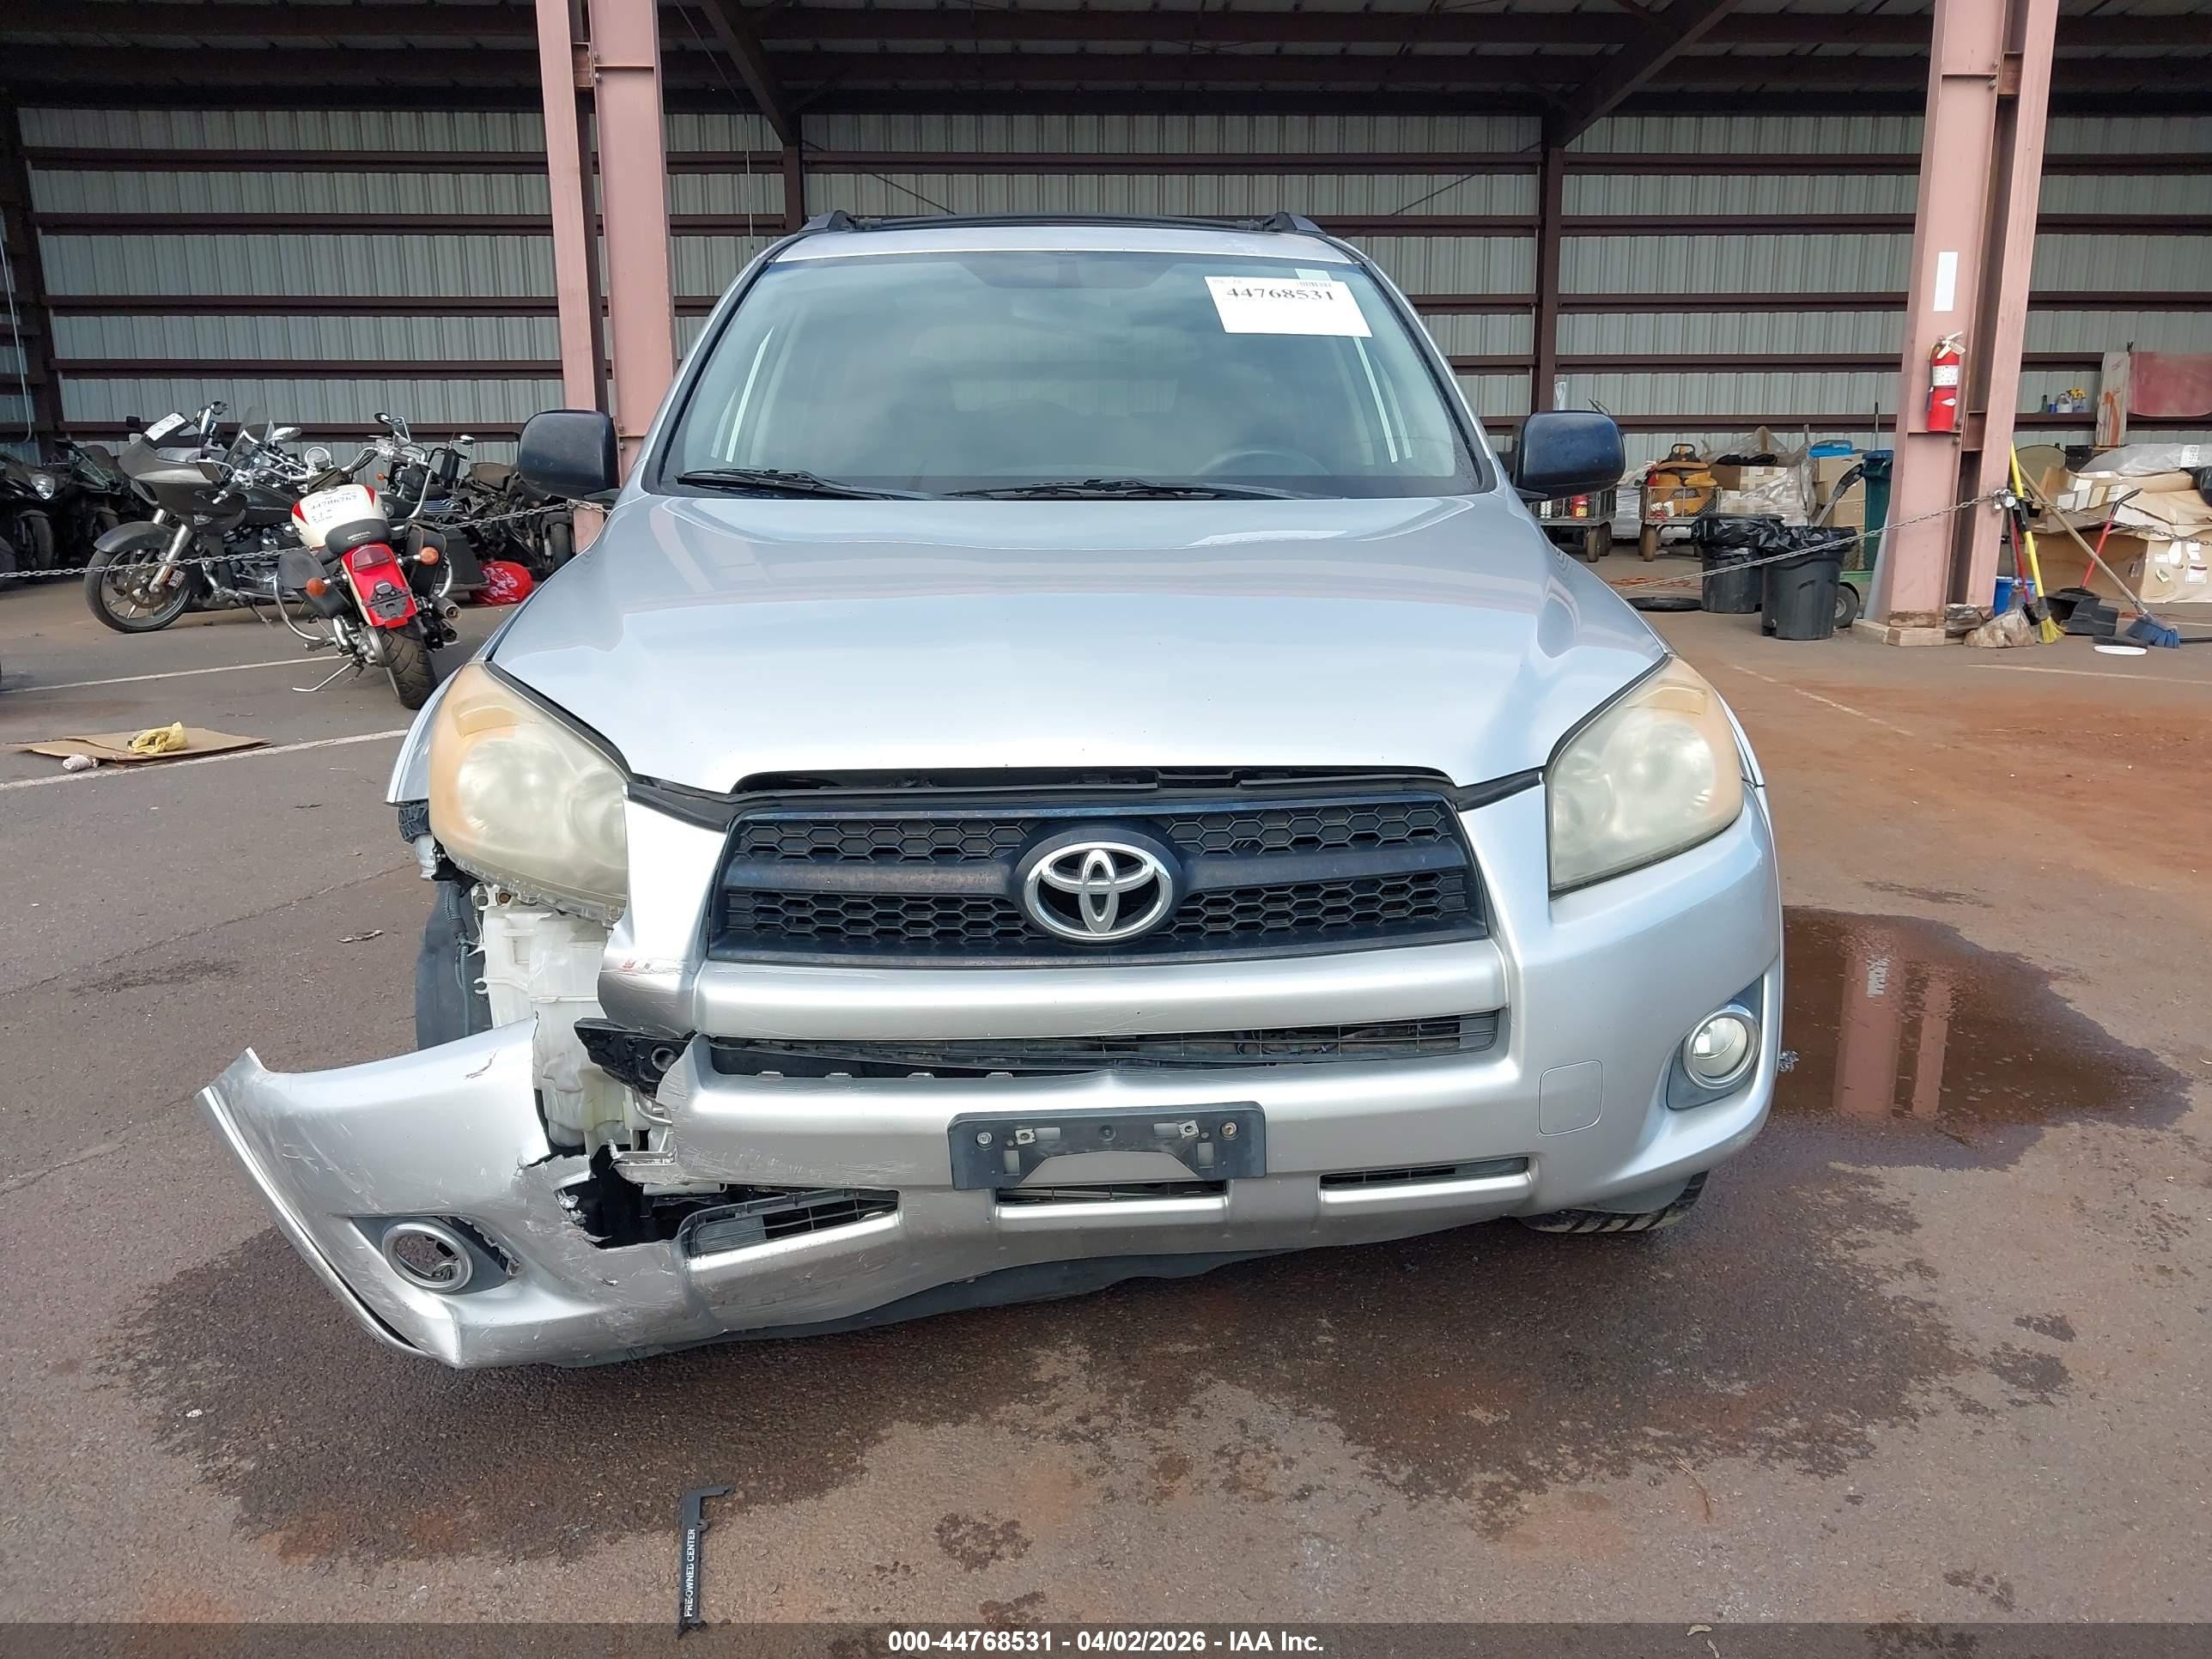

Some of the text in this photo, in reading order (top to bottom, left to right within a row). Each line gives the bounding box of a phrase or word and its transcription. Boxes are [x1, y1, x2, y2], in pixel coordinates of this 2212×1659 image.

[1226, 288, 1334, 301] 44768531
[684, 1528, 696, 1618] PRE-OWNED CENTER
